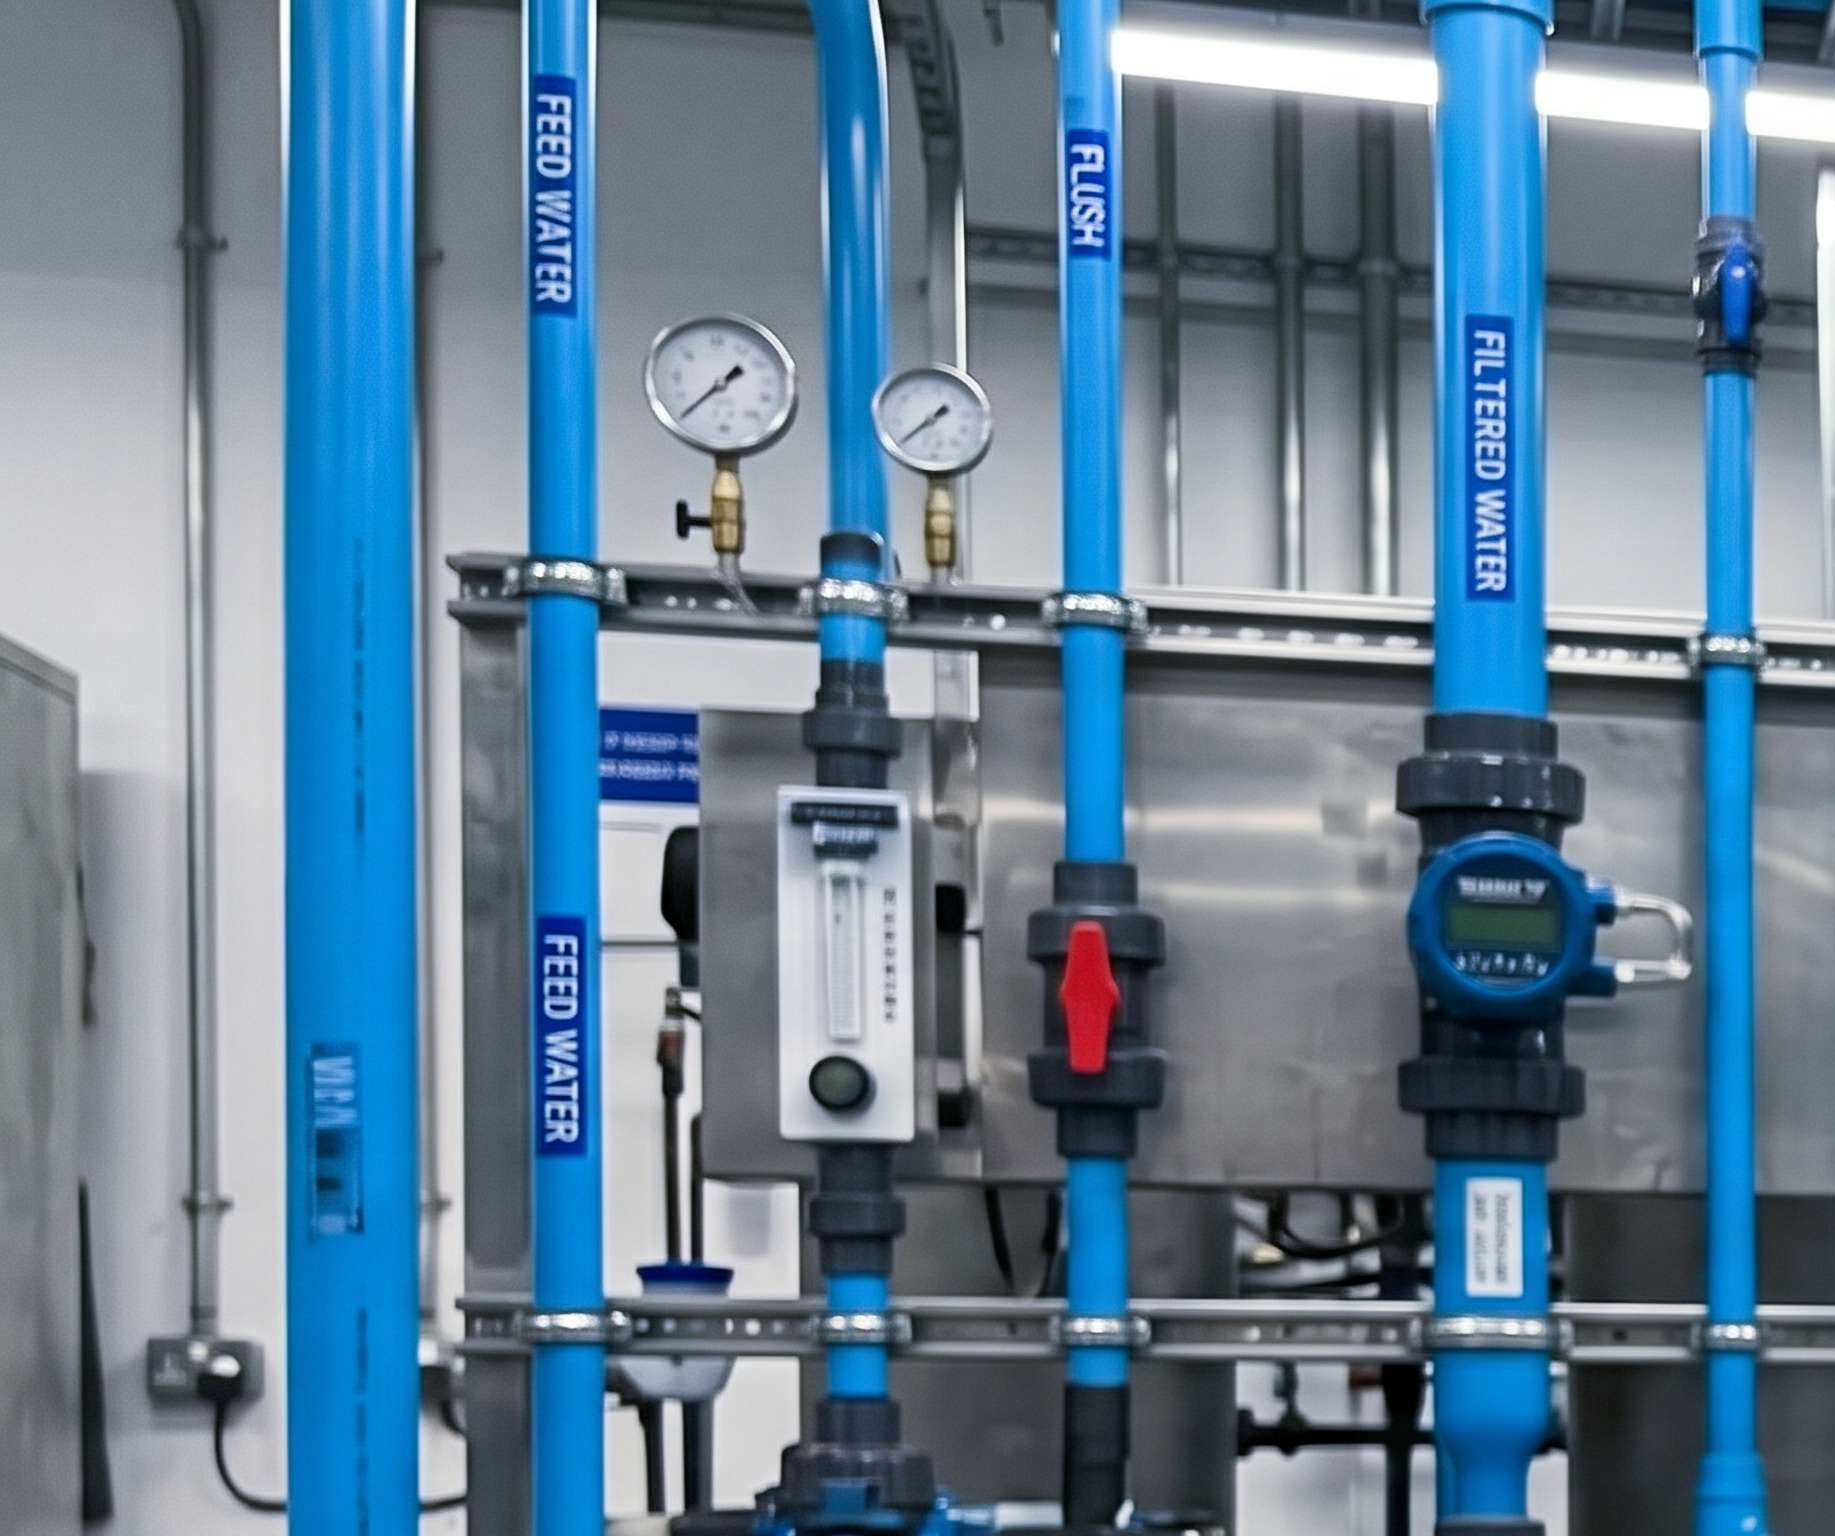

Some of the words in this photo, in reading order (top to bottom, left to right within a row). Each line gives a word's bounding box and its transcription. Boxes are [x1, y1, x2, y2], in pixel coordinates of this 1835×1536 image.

[536, 92, 572, 179] FEED
[536, 190, 572, 304] WATER
[1071, 144, 1105, 248] FLUSH
[1475, 330, 1507, 480] FILTERED
[1475, 489, 1507, 592] WATER
[545, 935, 580, 1019] FEED
[545, 1030, 580, 1144] WATER
